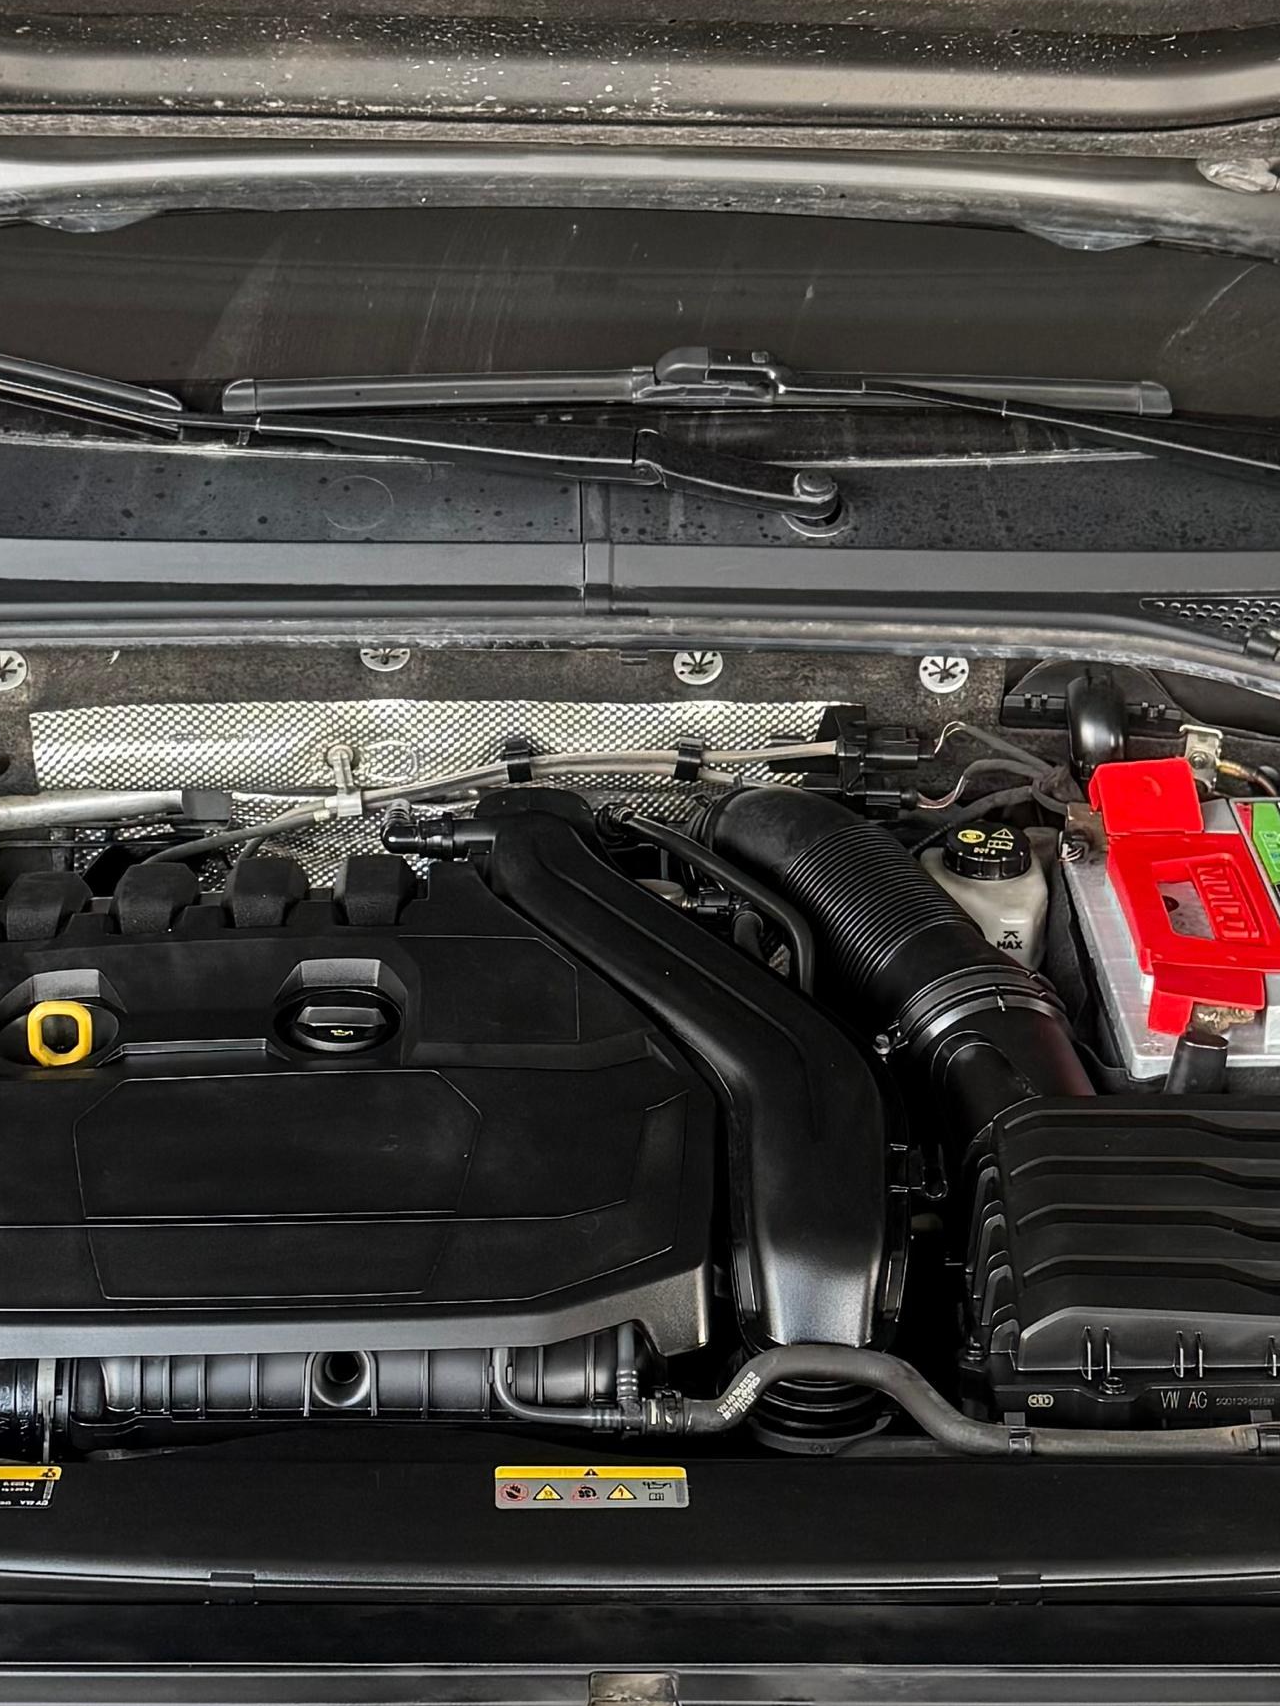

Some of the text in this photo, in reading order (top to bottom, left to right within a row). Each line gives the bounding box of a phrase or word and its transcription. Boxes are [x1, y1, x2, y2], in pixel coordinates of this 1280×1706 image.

[996, 940, 1023, 950] MAX
[1160, 1390, 1181, 1409] VW
[1187, 1390, 1208, 1409] AG
